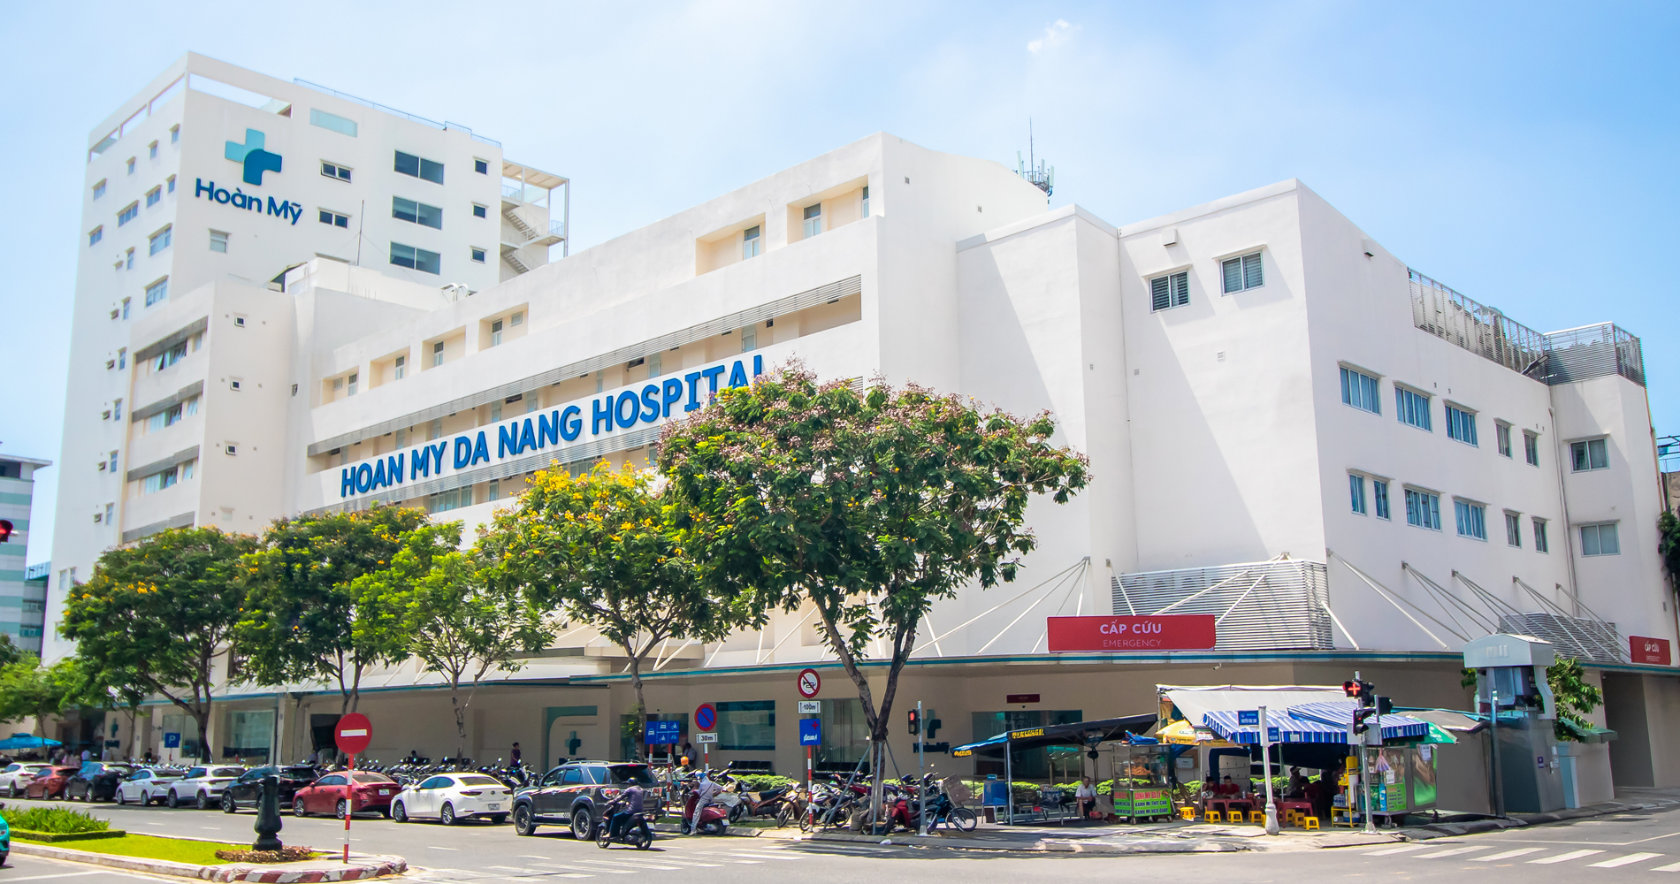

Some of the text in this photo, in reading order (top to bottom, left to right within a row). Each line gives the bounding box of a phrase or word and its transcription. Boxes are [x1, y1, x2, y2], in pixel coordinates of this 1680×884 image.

[195, 178, 303, 225] Hoàn Mỹ
[341, 453, 404, 498] HOAN
[410, 441, 447, 480] MY
[453, 431, 490, 469] DA
[498, 405, 582, 458] NANG
[1100, 619, 1162, 635] CẤP CỨU
[1103, 639, 1162, 648] EMERGENCY
